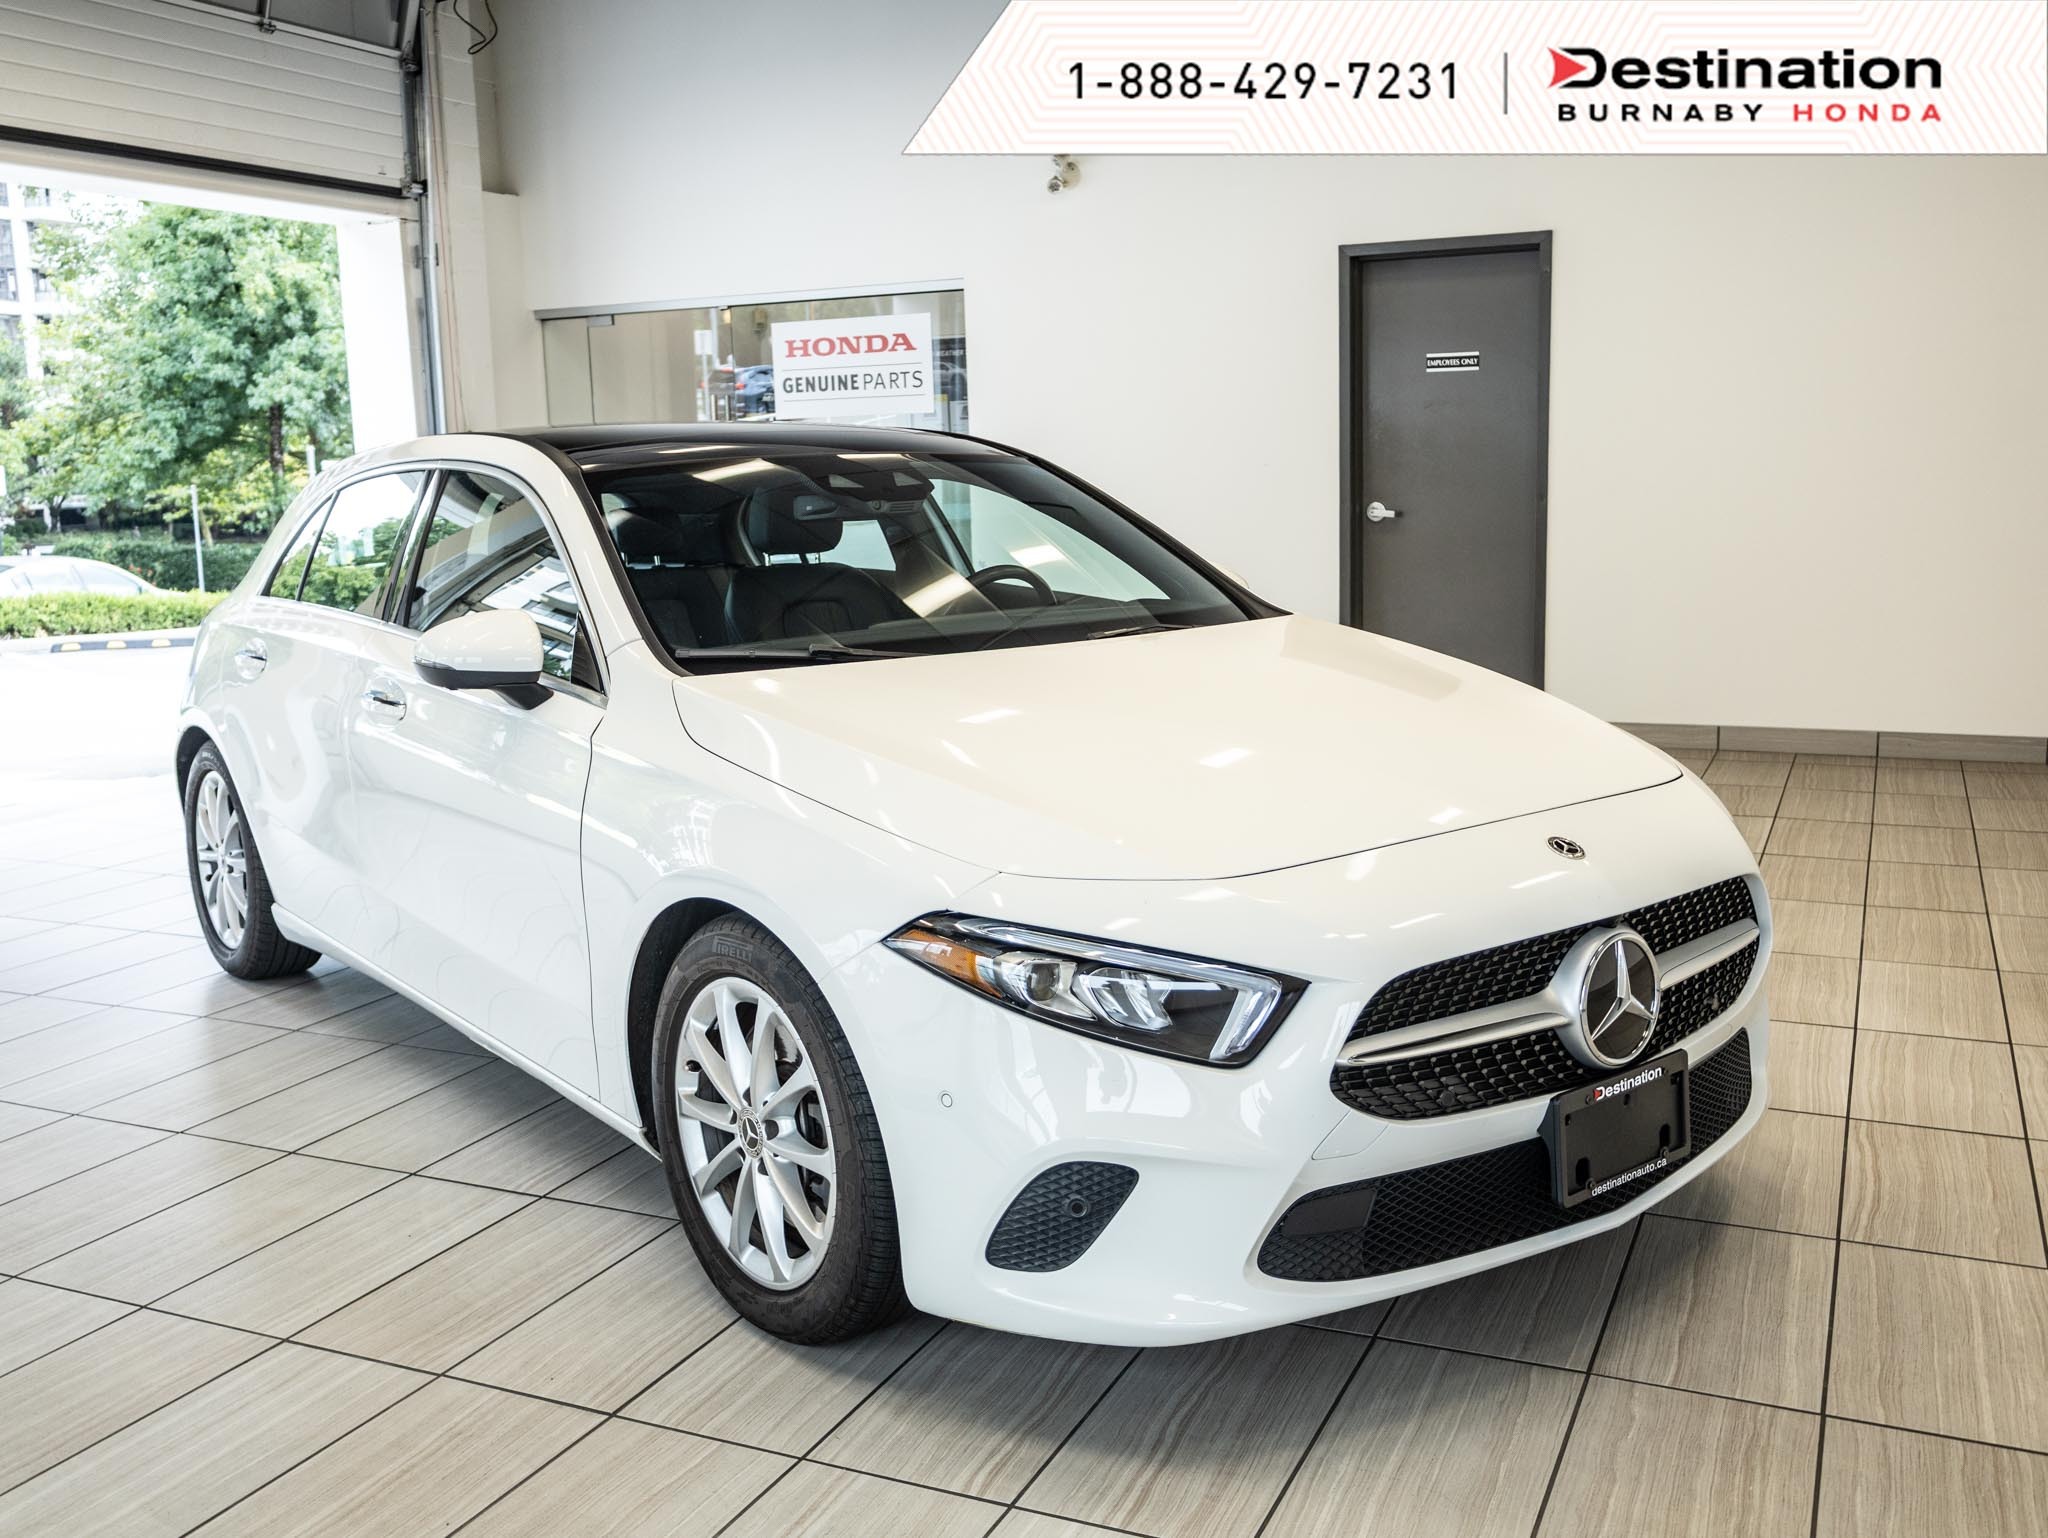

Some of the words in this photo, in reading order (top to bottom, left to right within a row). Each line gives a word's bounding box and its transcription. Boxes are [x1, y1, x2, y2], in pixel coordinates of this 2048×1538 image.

[785, 333, 917, 358] HONDA
[1427, 358, 1460, 367] EMPLOYEES
[1461, 357, 1478, 365] ONLY
[782, 373, 859, 394] GENUINE
[863, 370, 924, 391] PARTS
[712, 935, 754, 963] PIRELLI
[1593, 1066, 1663, 1102] Destination
[1591, 1157, 1667, 1197] destinationauto.ca
